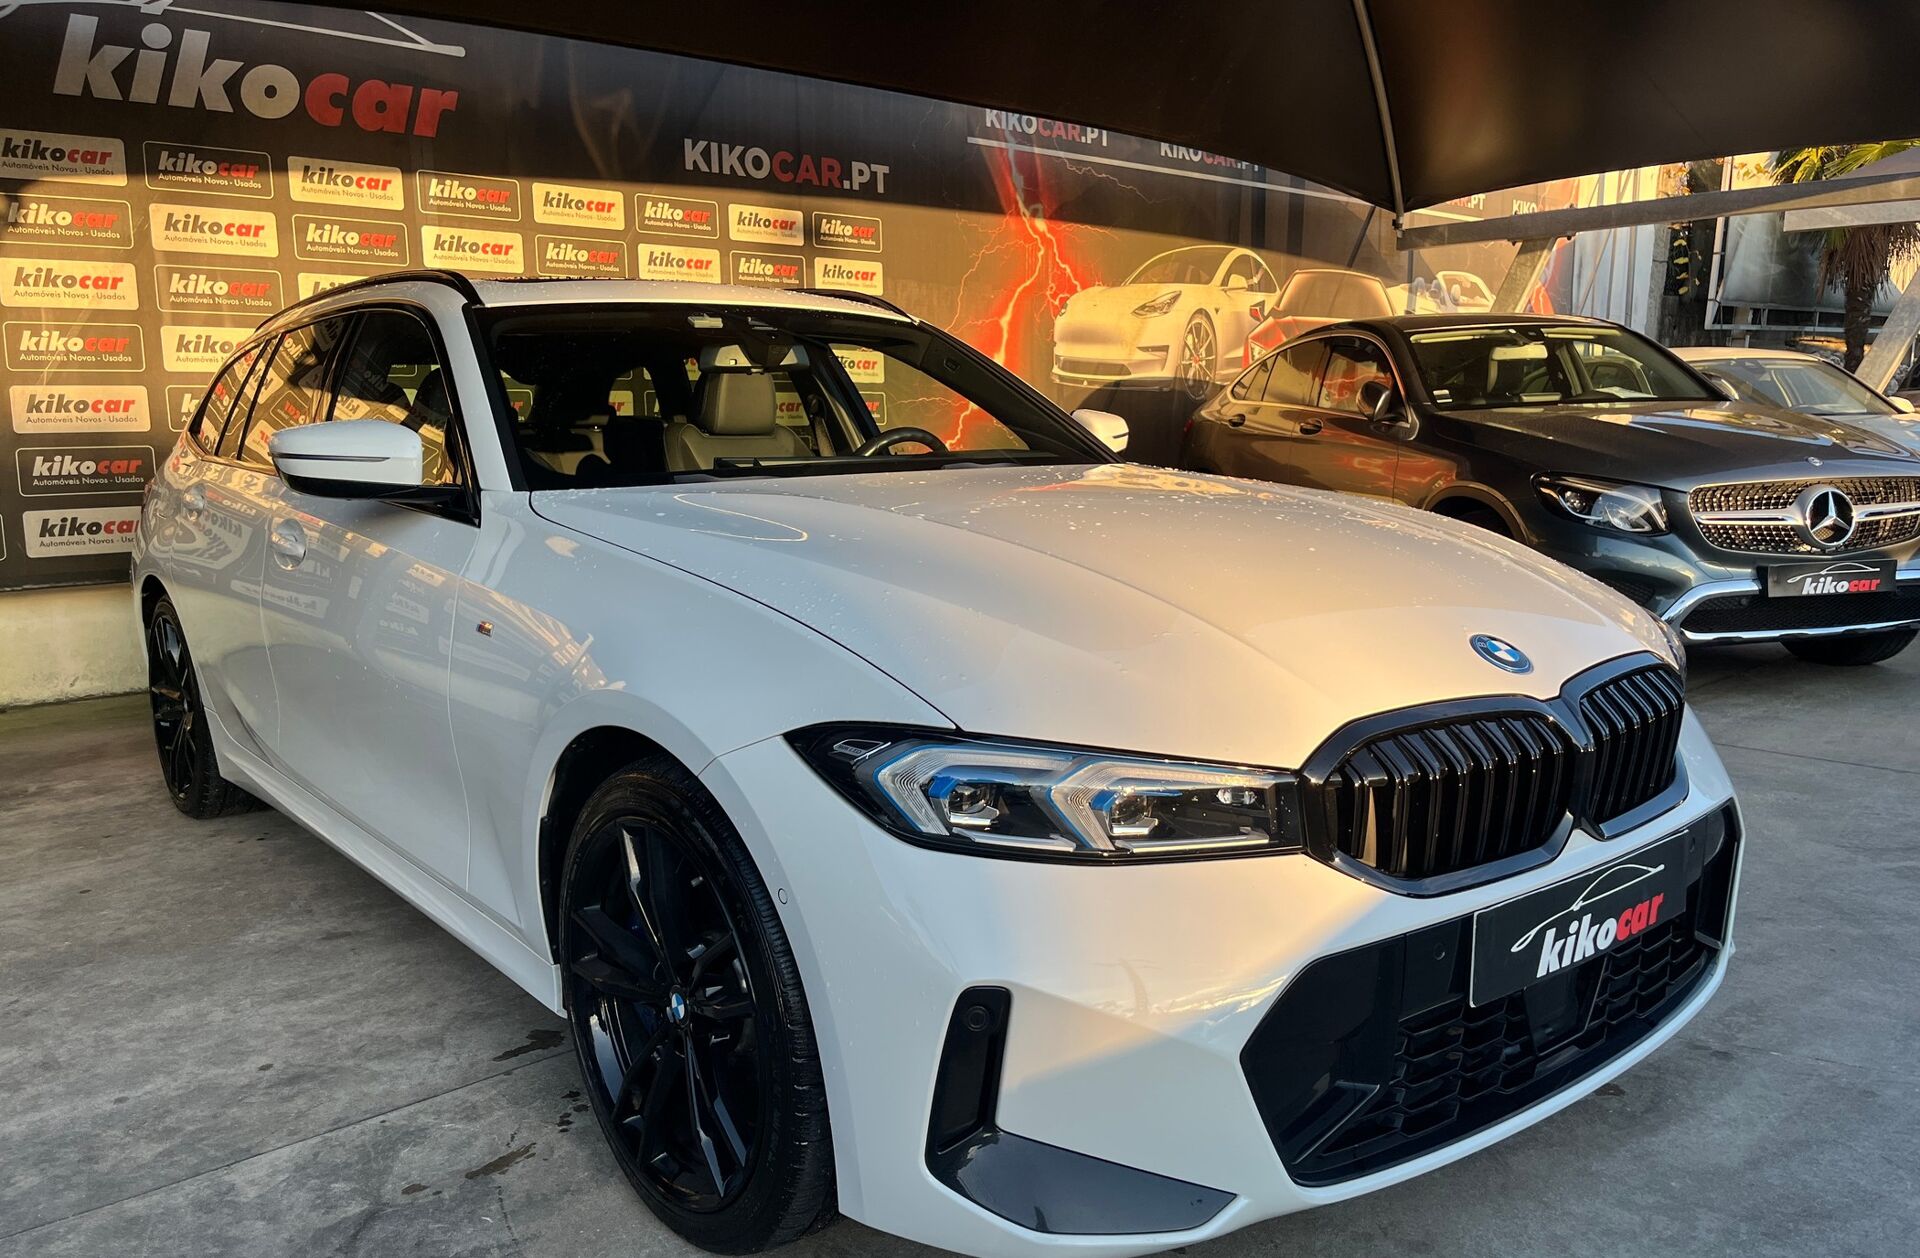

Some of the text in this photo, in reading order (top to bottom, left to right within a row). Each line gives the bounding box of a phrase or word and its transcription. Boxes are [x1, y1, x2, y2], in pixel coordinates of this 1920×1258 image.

[53, 13, 459, 138] kikocar
[1, 137, 112, 165] kikocar
[158, 151, 259, 178] kikocar
[684, 138, 889, 193] KIKOCAR.PT
[204, 176, 228, 185] Novos
[302, 165, 392, 191] kikocar
[429, 179, 510, 203] kikocar
[543, 192, 615, 213] kikocar
[645, 201, 711, 223] kikocar
[8, 202, 118, 228] kikocar
[165, 213, 264, 237] kikocar
[737, 211, 796, 230] kikocar
[306, 223, 396, 247] kikocar
[821, 218, 876, 237] kikocar
[434, 234, 513, 256] kikocar
[546, 243, 618, 263] kikocar
[648, 251, 712, 270] kikocar
[739, 258, 798, 276] kikocar
[14, 267, 124, 290] kikocar
[823, 264, 876, 281] kikocar
[170, 273, 270, 296] kikocar
[20, 330, 129, 352] kikocar
[176, 334, 243, 353] kiko
[26, 394, 135, 413] kikocar
[33, 456, 142, 476] kikocar
[1802, 576, 1881, 595] kikocar
[1536, 892, 1664, 978] kikocar
